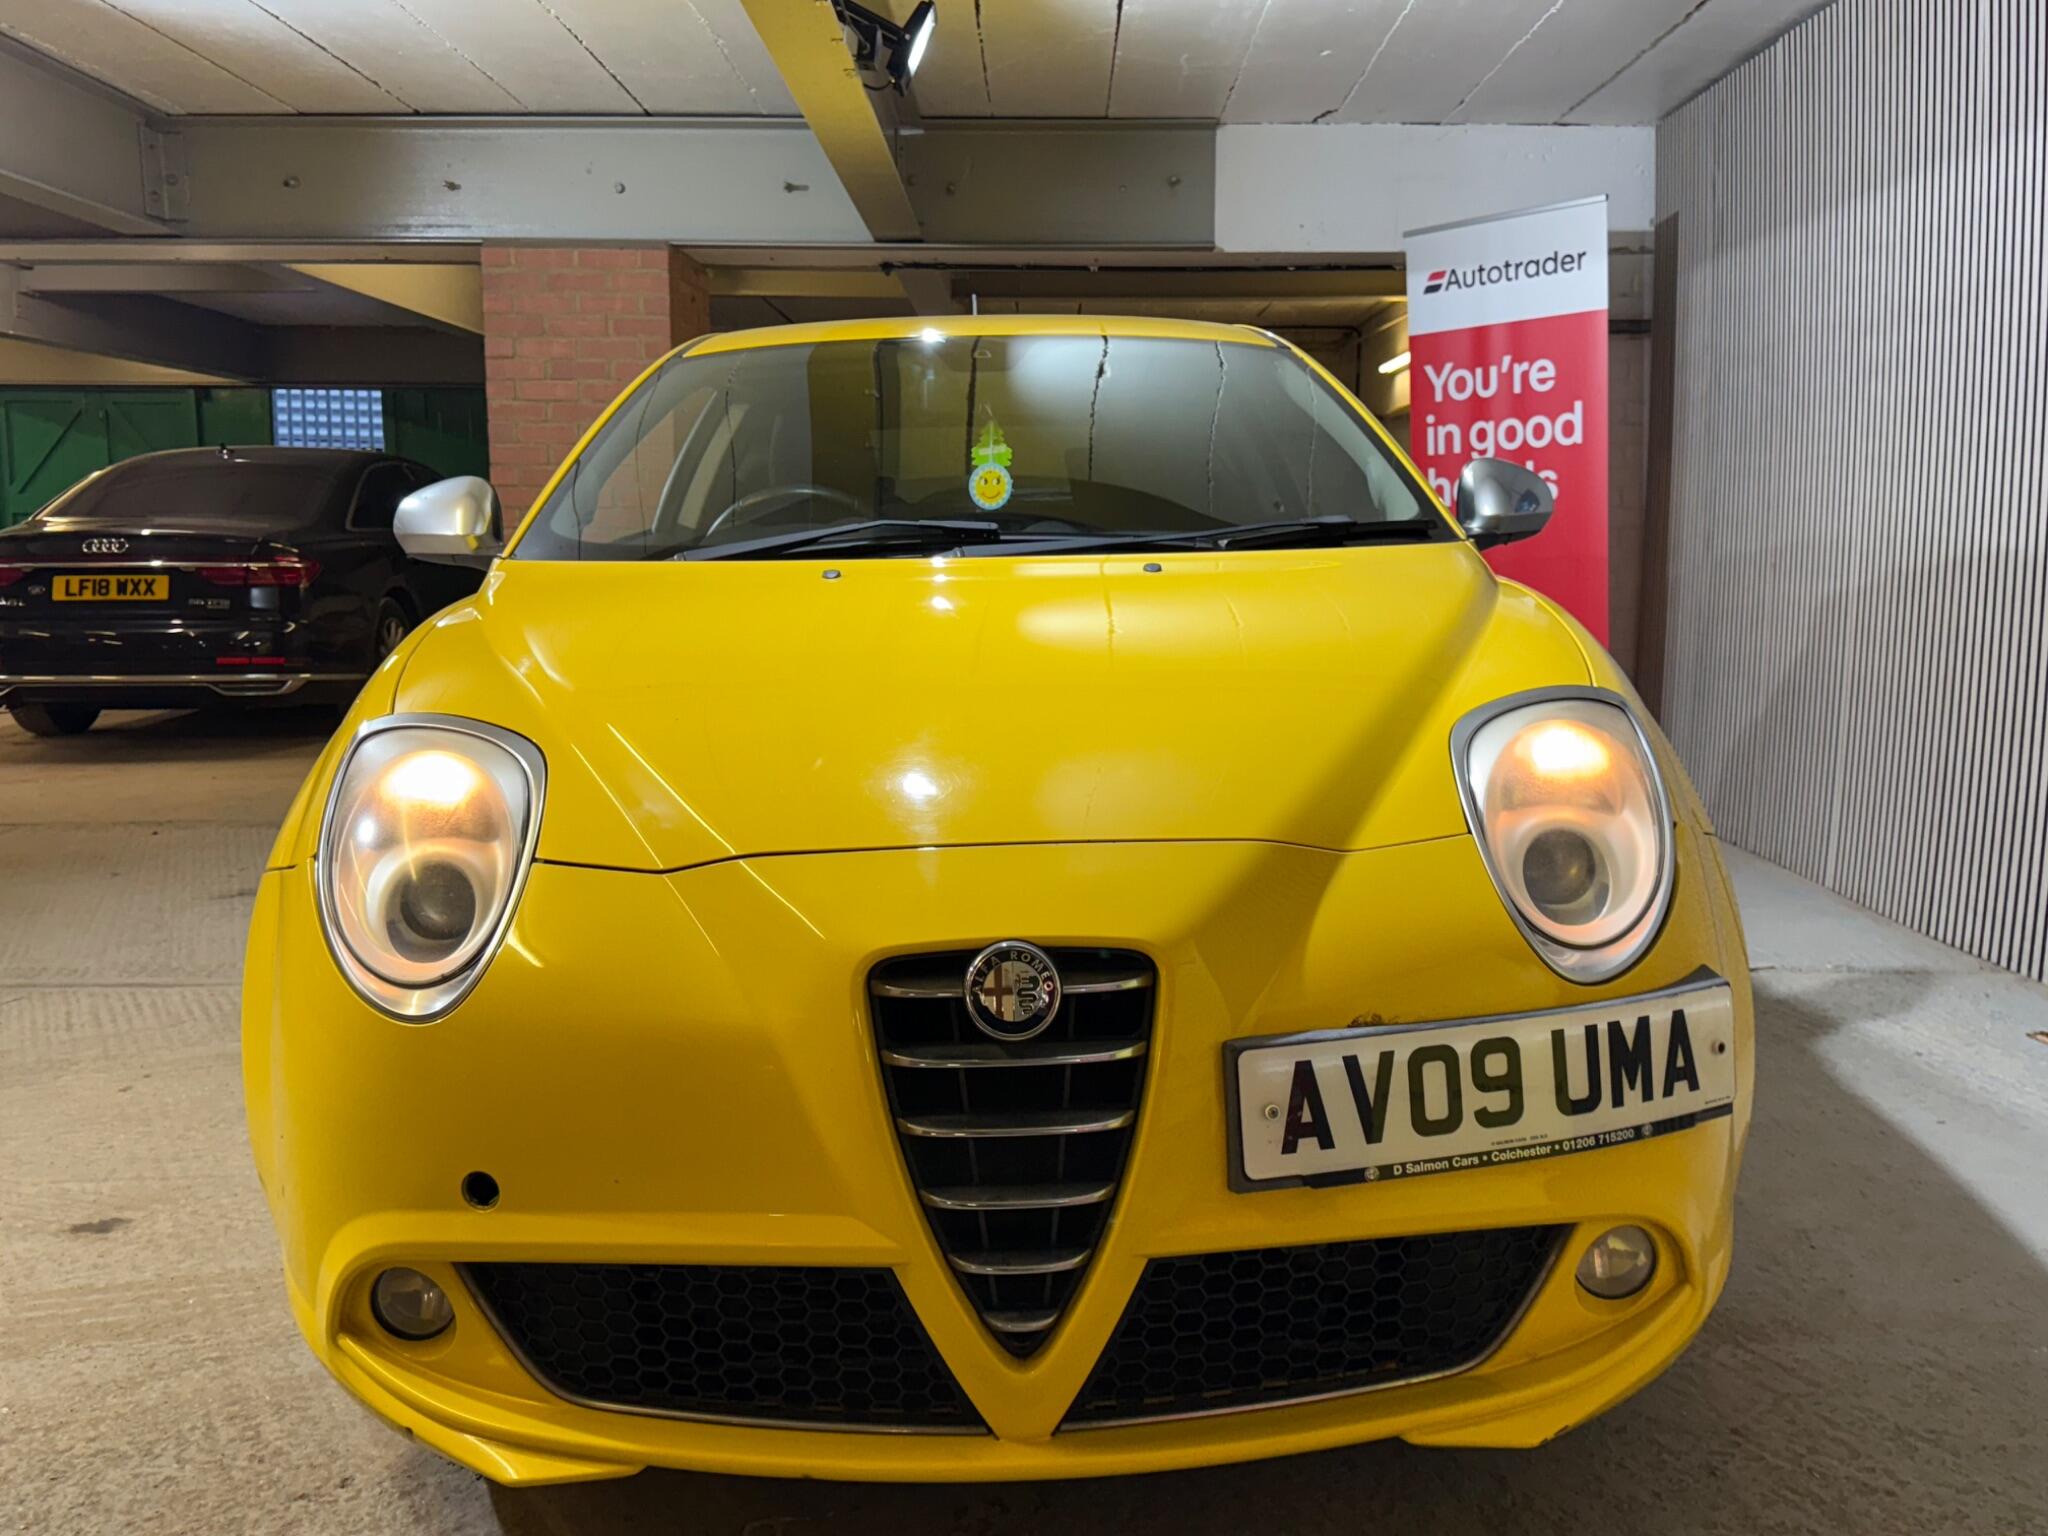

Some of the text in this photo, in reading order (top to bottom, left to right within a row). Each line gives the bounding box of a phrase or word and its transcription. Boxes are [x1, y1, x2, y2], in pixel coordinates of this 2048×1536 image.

[1445, 251, 1586, 291] Autotrader
[1426, 400, 1583, 460] in good
[65, 578, 156, 597] LF18 WXX
[1010, 950, 1054, 991] ROMEO
[1281, 1008, 1700, 1155] AV09 UMA
[1393, 1165, 1402, 1176] D
[1406, 1159, 1449, 1174] Salmon
[1452, 1155, 1479, 1167] Cars
[1491, 1144, 1552, 1162] Colchester
[1562, 1136, 1596, 1151] 01206
[1599, 1129, 1635, 1145] 715200
